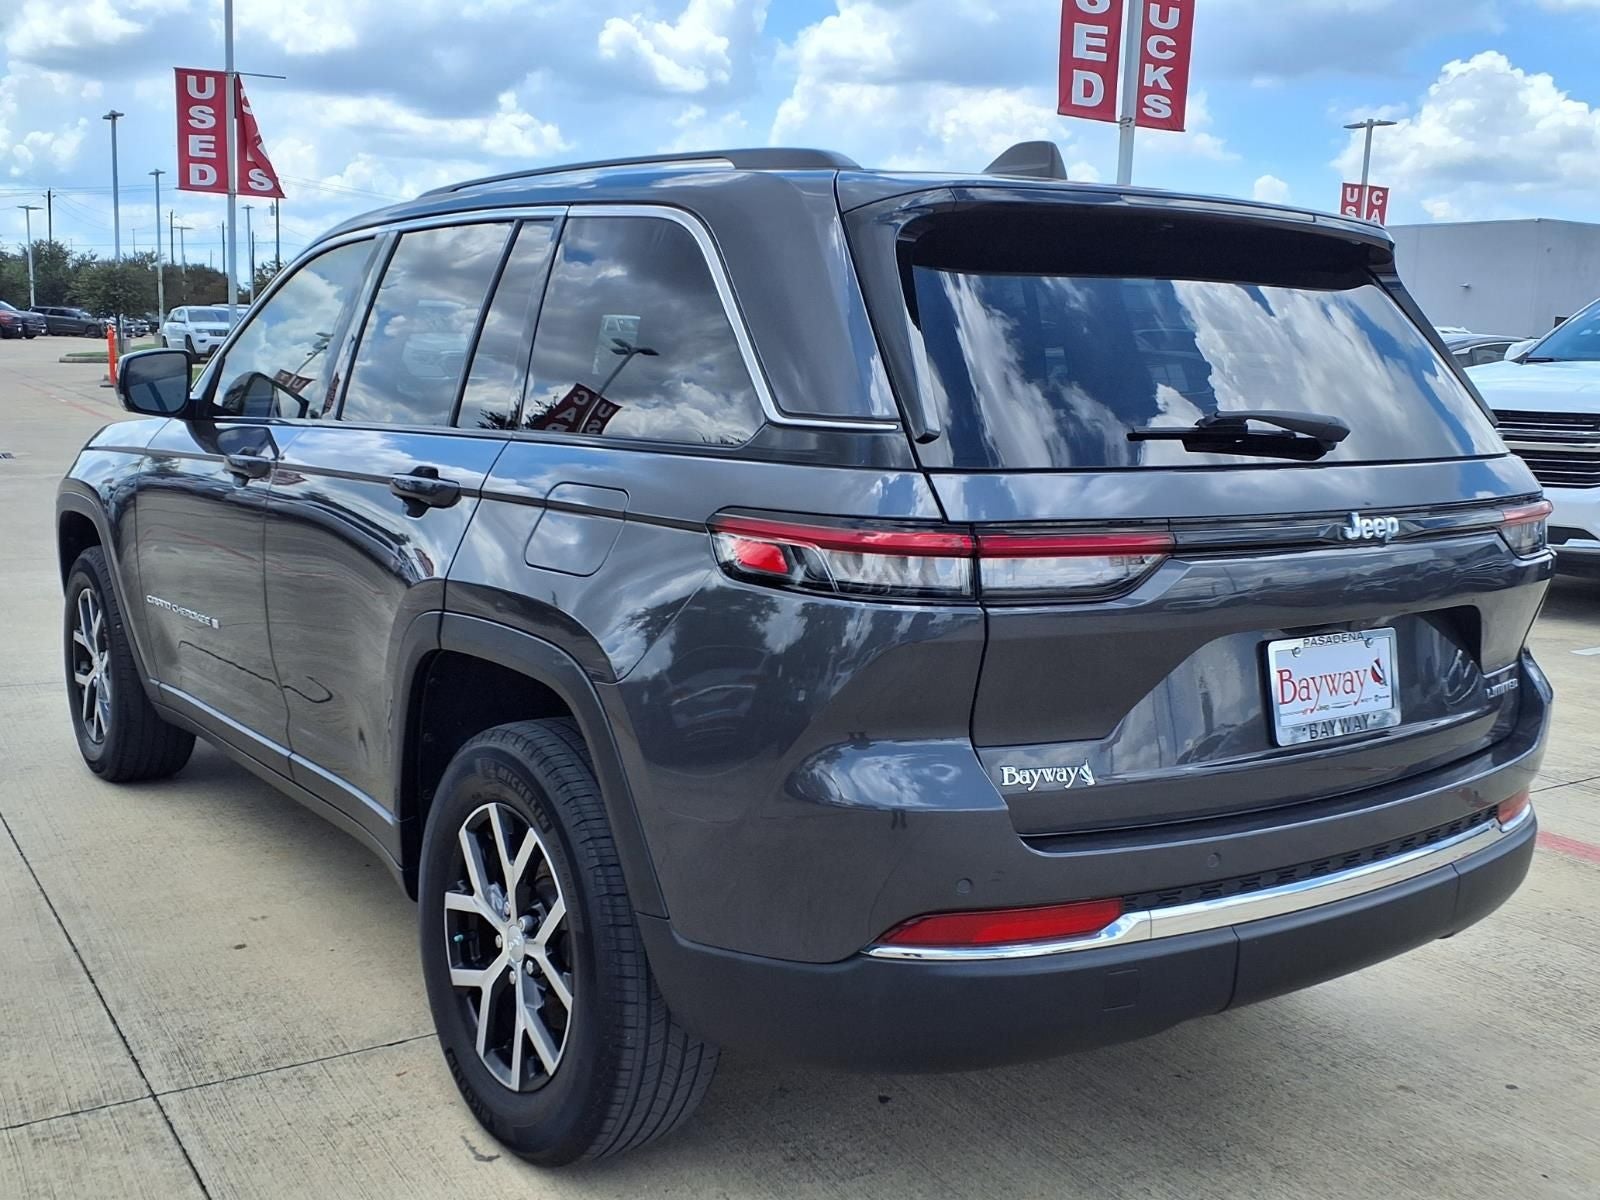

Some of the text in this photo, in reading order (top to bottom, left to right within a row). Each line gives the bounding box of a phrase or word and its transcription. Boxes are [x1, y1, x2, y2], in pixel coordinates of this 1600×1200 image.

[1142, 0, 1181, 119] UCKS
[186, 75, 218, 187] USED
[1343, 511, 1400, 544] Jeep
[1302, 631, 1365, 649] PASADENA
[1276, 668, 1368, 714] Bayway
[1308, 713, 1371, 740] BAYWAY
[1000, 765, 1080, 792] Bayway
[497, 766, 551, 833] MICHELIN
